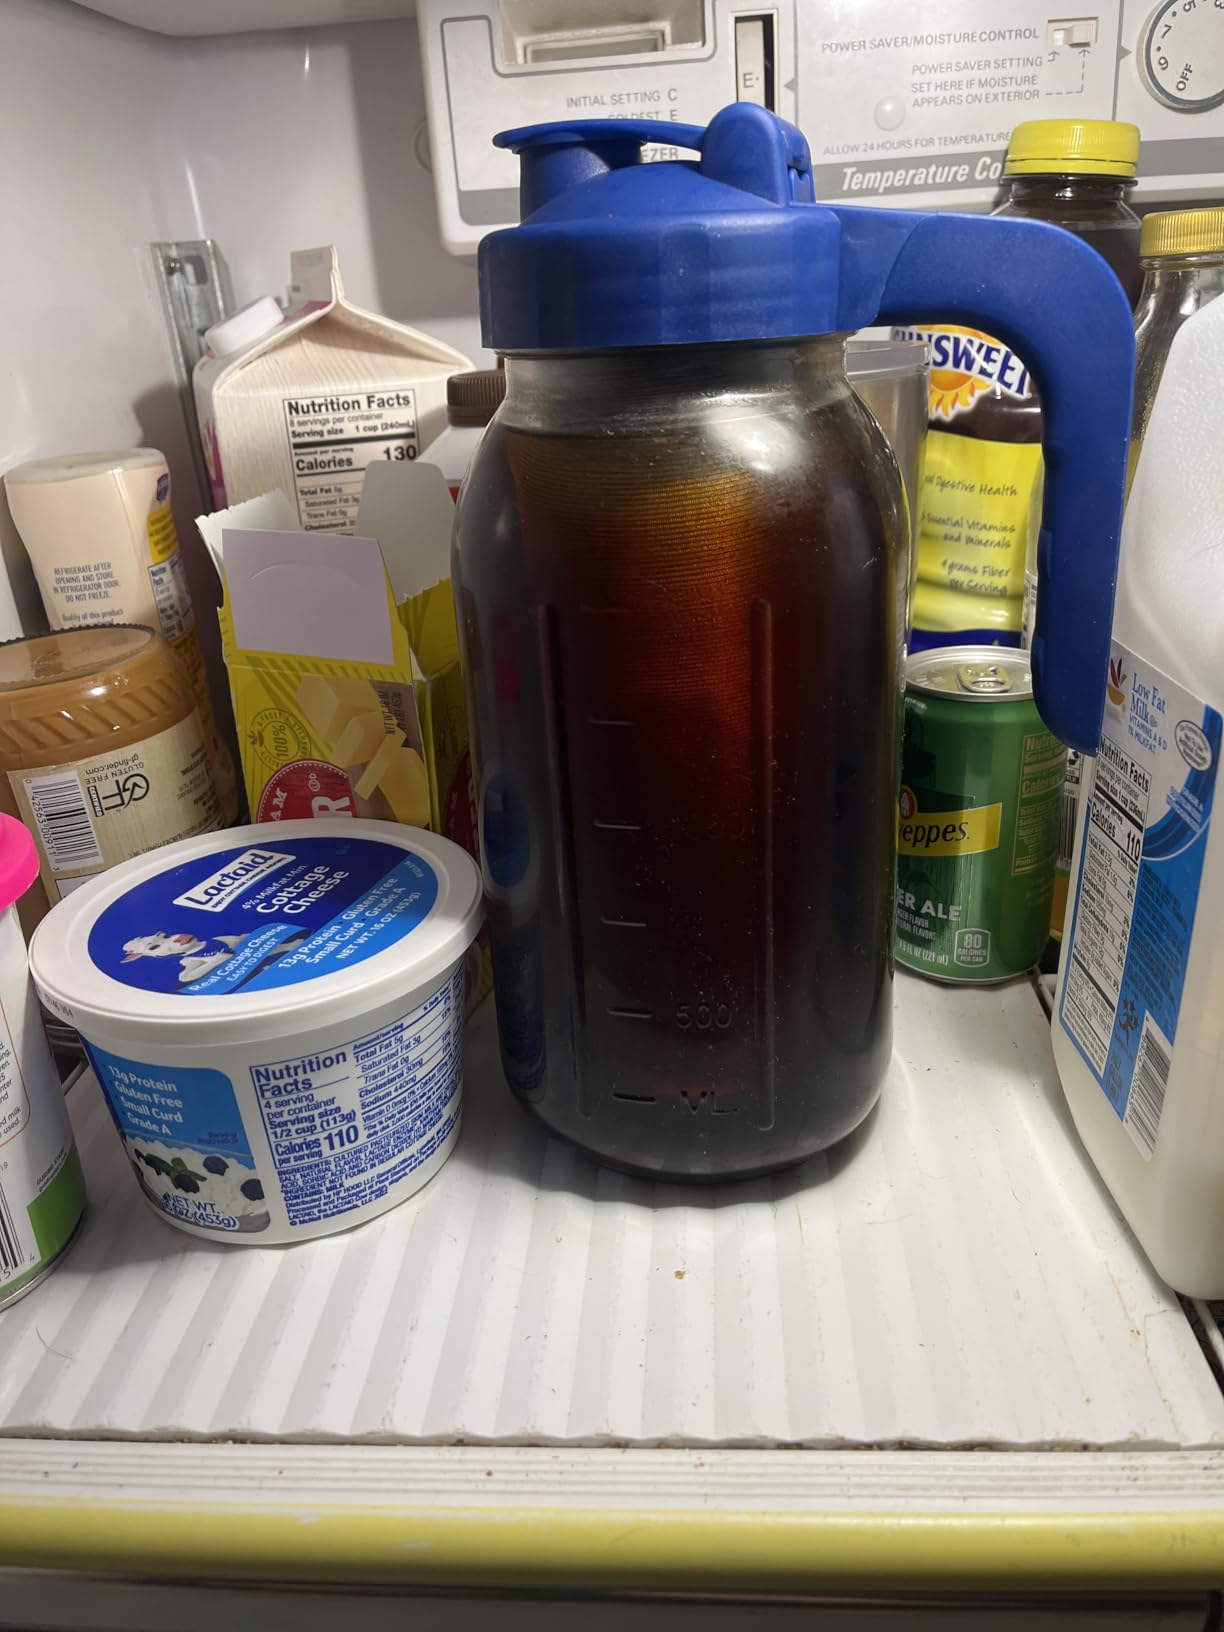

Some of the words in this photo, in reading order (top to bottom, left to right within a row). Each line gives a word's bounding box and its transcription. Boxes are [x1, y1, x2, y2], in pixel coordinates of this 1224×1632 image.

[821, 40, 866, 54] POWER
[869, 33, 977, 50] SAVER/MOISTURE
[979, 28, 1039, 42] CONTROL
[1161, 24, 1172, 39] 7
[912, 63, 953, 75] POWER
[955, 60, 991, 73] SAVER
[993, 56, 1043, 69] SETTING
[1158, 57, 1168, 70] 9
[911, 82, 931, 94] SET
[934, 80, 963, 92] HERE
[966, 78, 976, 90] IF
[978, 75, 1038, 89] MOISTURE
[1176, 63, 1192, 91] OFF
[566, 96, 607, 108] INITIAL
[610, 90, 661, 105] SETTING
[667, 88, 678, 101] C
[912, 94, 963, 109] APPEARS
[965, 94, 983, 105] ON
[984, 89, 1040, 105] EXTERIOR
[669, 109, 678, 121] E
[823, 145, 859, 156] ALLOW
[862, 143, 875, 153] 24
[876, 140, 913, 151] HOURS
[914, 137, 935, 149] FOR
[937, 131, 1011, 147] TEMPERATURE
[841, 164, 968, 193] Temperature
[287, 397, 361, 416] Nutrition
[366, 392, 410, 410] Facts
[291, 429, 325, 438] Serving
[327, 426, 345, 436] size
[297, 416, 331, 428] servings
[332, 415, 345, 425] per
[347, 411, 384, 423] container
[363, 422, 378, 433] cup
[295, 455, 353, 472] Calories
[383, 443, 418, 462] 130
[936, 475, 977, 493] Digestive
[979, 484, 1018, 496] Health
[966, 519, 1016, 534] Vitamins
[943, 532, 962, 543] and
[965, 535, 1011, 549] Minerals
[94, 561, 112, 572] AFTER
[947, 561, 979, 575] grams
[982, 565, 1011, 578] Fiber
[55, 575, 81, 585] OPENING
[82, 574, 95, 582] AND
[966, 579, 1008, 596] Serving
[75, 592, 86, 601] NOT
[1132, 672, 1150, 700] Low
[1151, 686, 1166, 715] Fat
[1131, 692, 1149, 723] Milk
[272, 725, 289, 758] 100%
[85, 753, 139, 776] gf-finder.com
[111, 761, 145, 777] GLUTEN
[1100, 735, 1129, 776] Nutrition
[1130, 763, 1149, 792] Facts
[85, 773, 109, 785] FREE
[1091, 800, 1116, 838] Calories
[1126, 829, 1141, 861] 110
[184, 852, 274, 906] Lactaid
[255, 864, 330, 914] Cottage
[282, 869, 350, 914] Cheese
[921, 899, 962, 921] ALE
[278, 951, 306, 971] 13g
[300, 925, 342, 959] Protein
[342, 896, 374, 922] Gluten
[371, 876, 399, 901] Free
[304, 937, 340, 965] Small
[336, 920, 366, 945] Curd
[365, 892, 399, 919] Grade
[395, 886, 407, 898] A
[335, 942, 361, 961] NET
[376, 921, 386, 933] 16
[384, 912, 398, 925] OZ
[963, 933, 982, 949] 80
[189, 972, 220, 993] Real
[217, 945, 254, 977] Cottage
[250, 923, 289, 951] Cheese
[226, 966, 246, 983] EASY
[244, 957, 257, 970] TO
[254, 936, 281, 961] DIGEST
[676, 1004, 733, 1029] 500
[355, 1046, 378, 1064] Total
[379, 1041, 393, 1054] Fat
[393, 1034, 405, 1046] 5g
[361, 1048, 400, 1073] Saturated
[400, 1040, 412, 1056] Fat
[412, 1034, 422, 1045] 3g
[108, 1064, 130, 1084] 13g
[129, 1073, 178, 1093] Protein
[254, 1051, 348, 1084] Nutrition
[359, 1069, 405, 1099] Cholesterol
[405, 1057, 424, 1075] 30mg
[364, 1068, 387, 1084] Trans
[386, 1061, 399, 1074] Fat
[400, 1054, 410, 1067] 0g
[114, 1081, 152, 1103] Gluten
[152, 1093, 184, 1109] Free
[259, 1077, 313, 1098] Facts
[361, 1089, 393, 1110] Sodium
[393, 1074, 418, 1094] 440mg
[7, 1106, 22, 1121] milk
[120, 1096, 151, 1117] Small
[151, 1107, 184, 1123] Curd
[264, 1099, 272, 1110] 4
[274, 1092, 315, 1109] serving
[266, 1108, 285, 1121] per
[287, 1095, 337, 1117] container
[127, 1112, 160, 1133] Grade
[160, 1123, 172, 1136] A
[269, 1113, 315, 1131] Serving
[317, 1106, 342, 1120] size
[271, 1127, 293, 1140] 1/2
[294, 1123, 318, 1136] cup
[320, 1108, 356, 1132] (113g)
[274, 1137, 322, 1157] Calories
[324, 1124, 360, 1151] 110
[278, 1156, 292, 1167] per
[292, 1149, 324, 1163] serving
[278, 1160, 332, 1176] INGREDIENTS:
[333, 1145, 369, 1163] CULTURED
[165, 1192, 190, 1209] NET
[193, 1210, 238, 1228] (453g)
